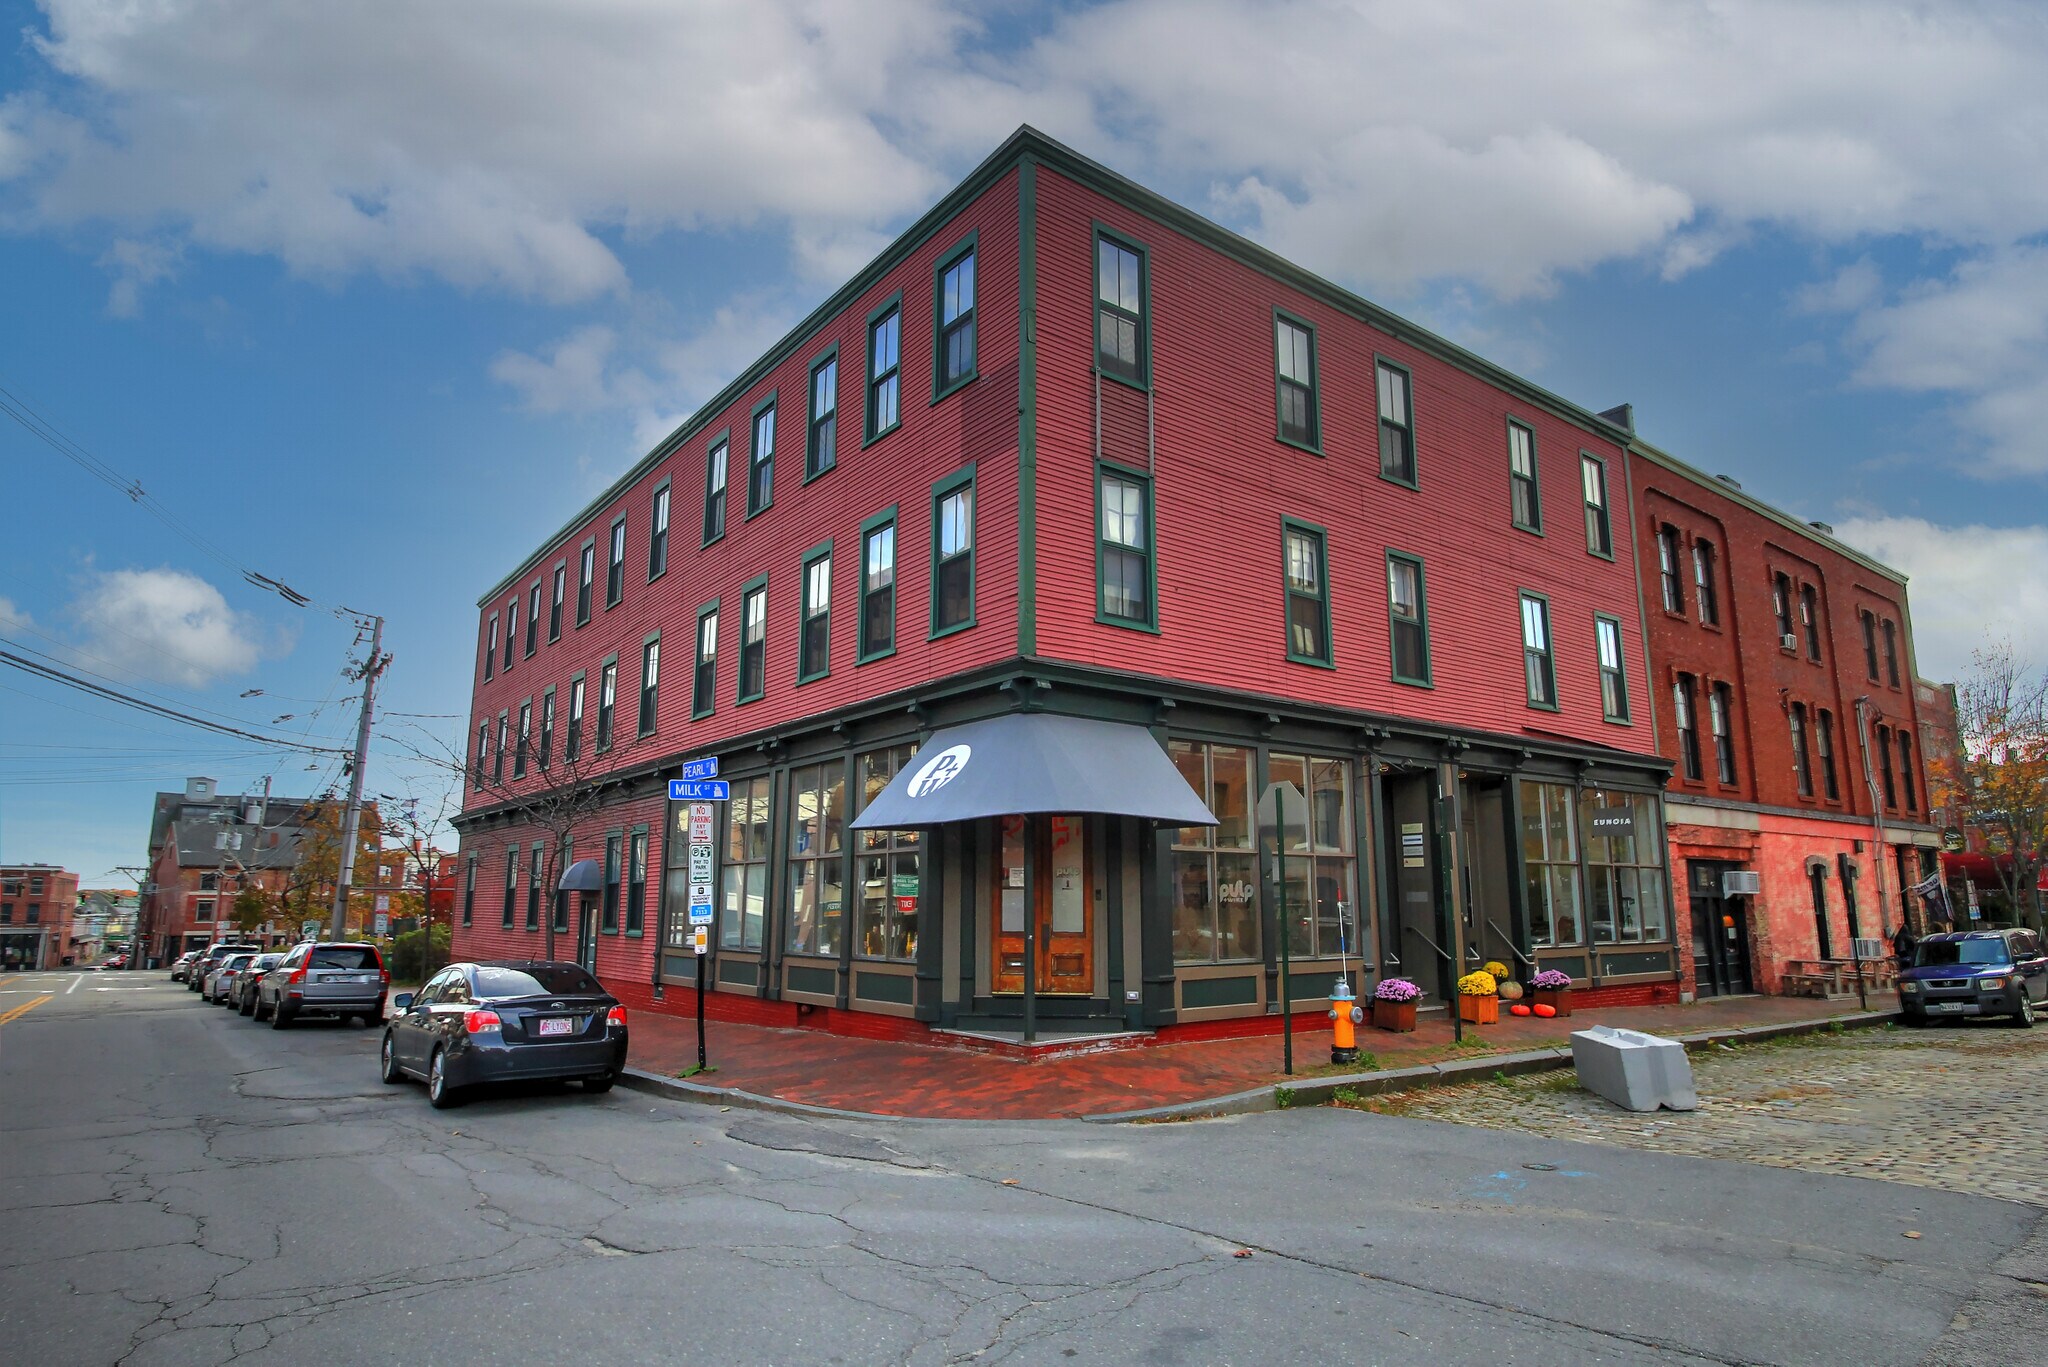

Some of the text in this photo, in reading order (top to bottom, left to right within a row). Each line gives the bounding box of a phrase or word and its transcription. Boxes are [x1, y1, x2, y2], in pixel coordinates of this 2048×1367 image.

[684, 763, 706, 779] PEARL
[675, 783, 702, 797] MILK
[696, 806, 706, 815] NO
[690, 815, 712, 824] PARKING
[1593, 818, 1632, 826] EUNOIA
[1220, 879, 1254, 903] pulp
